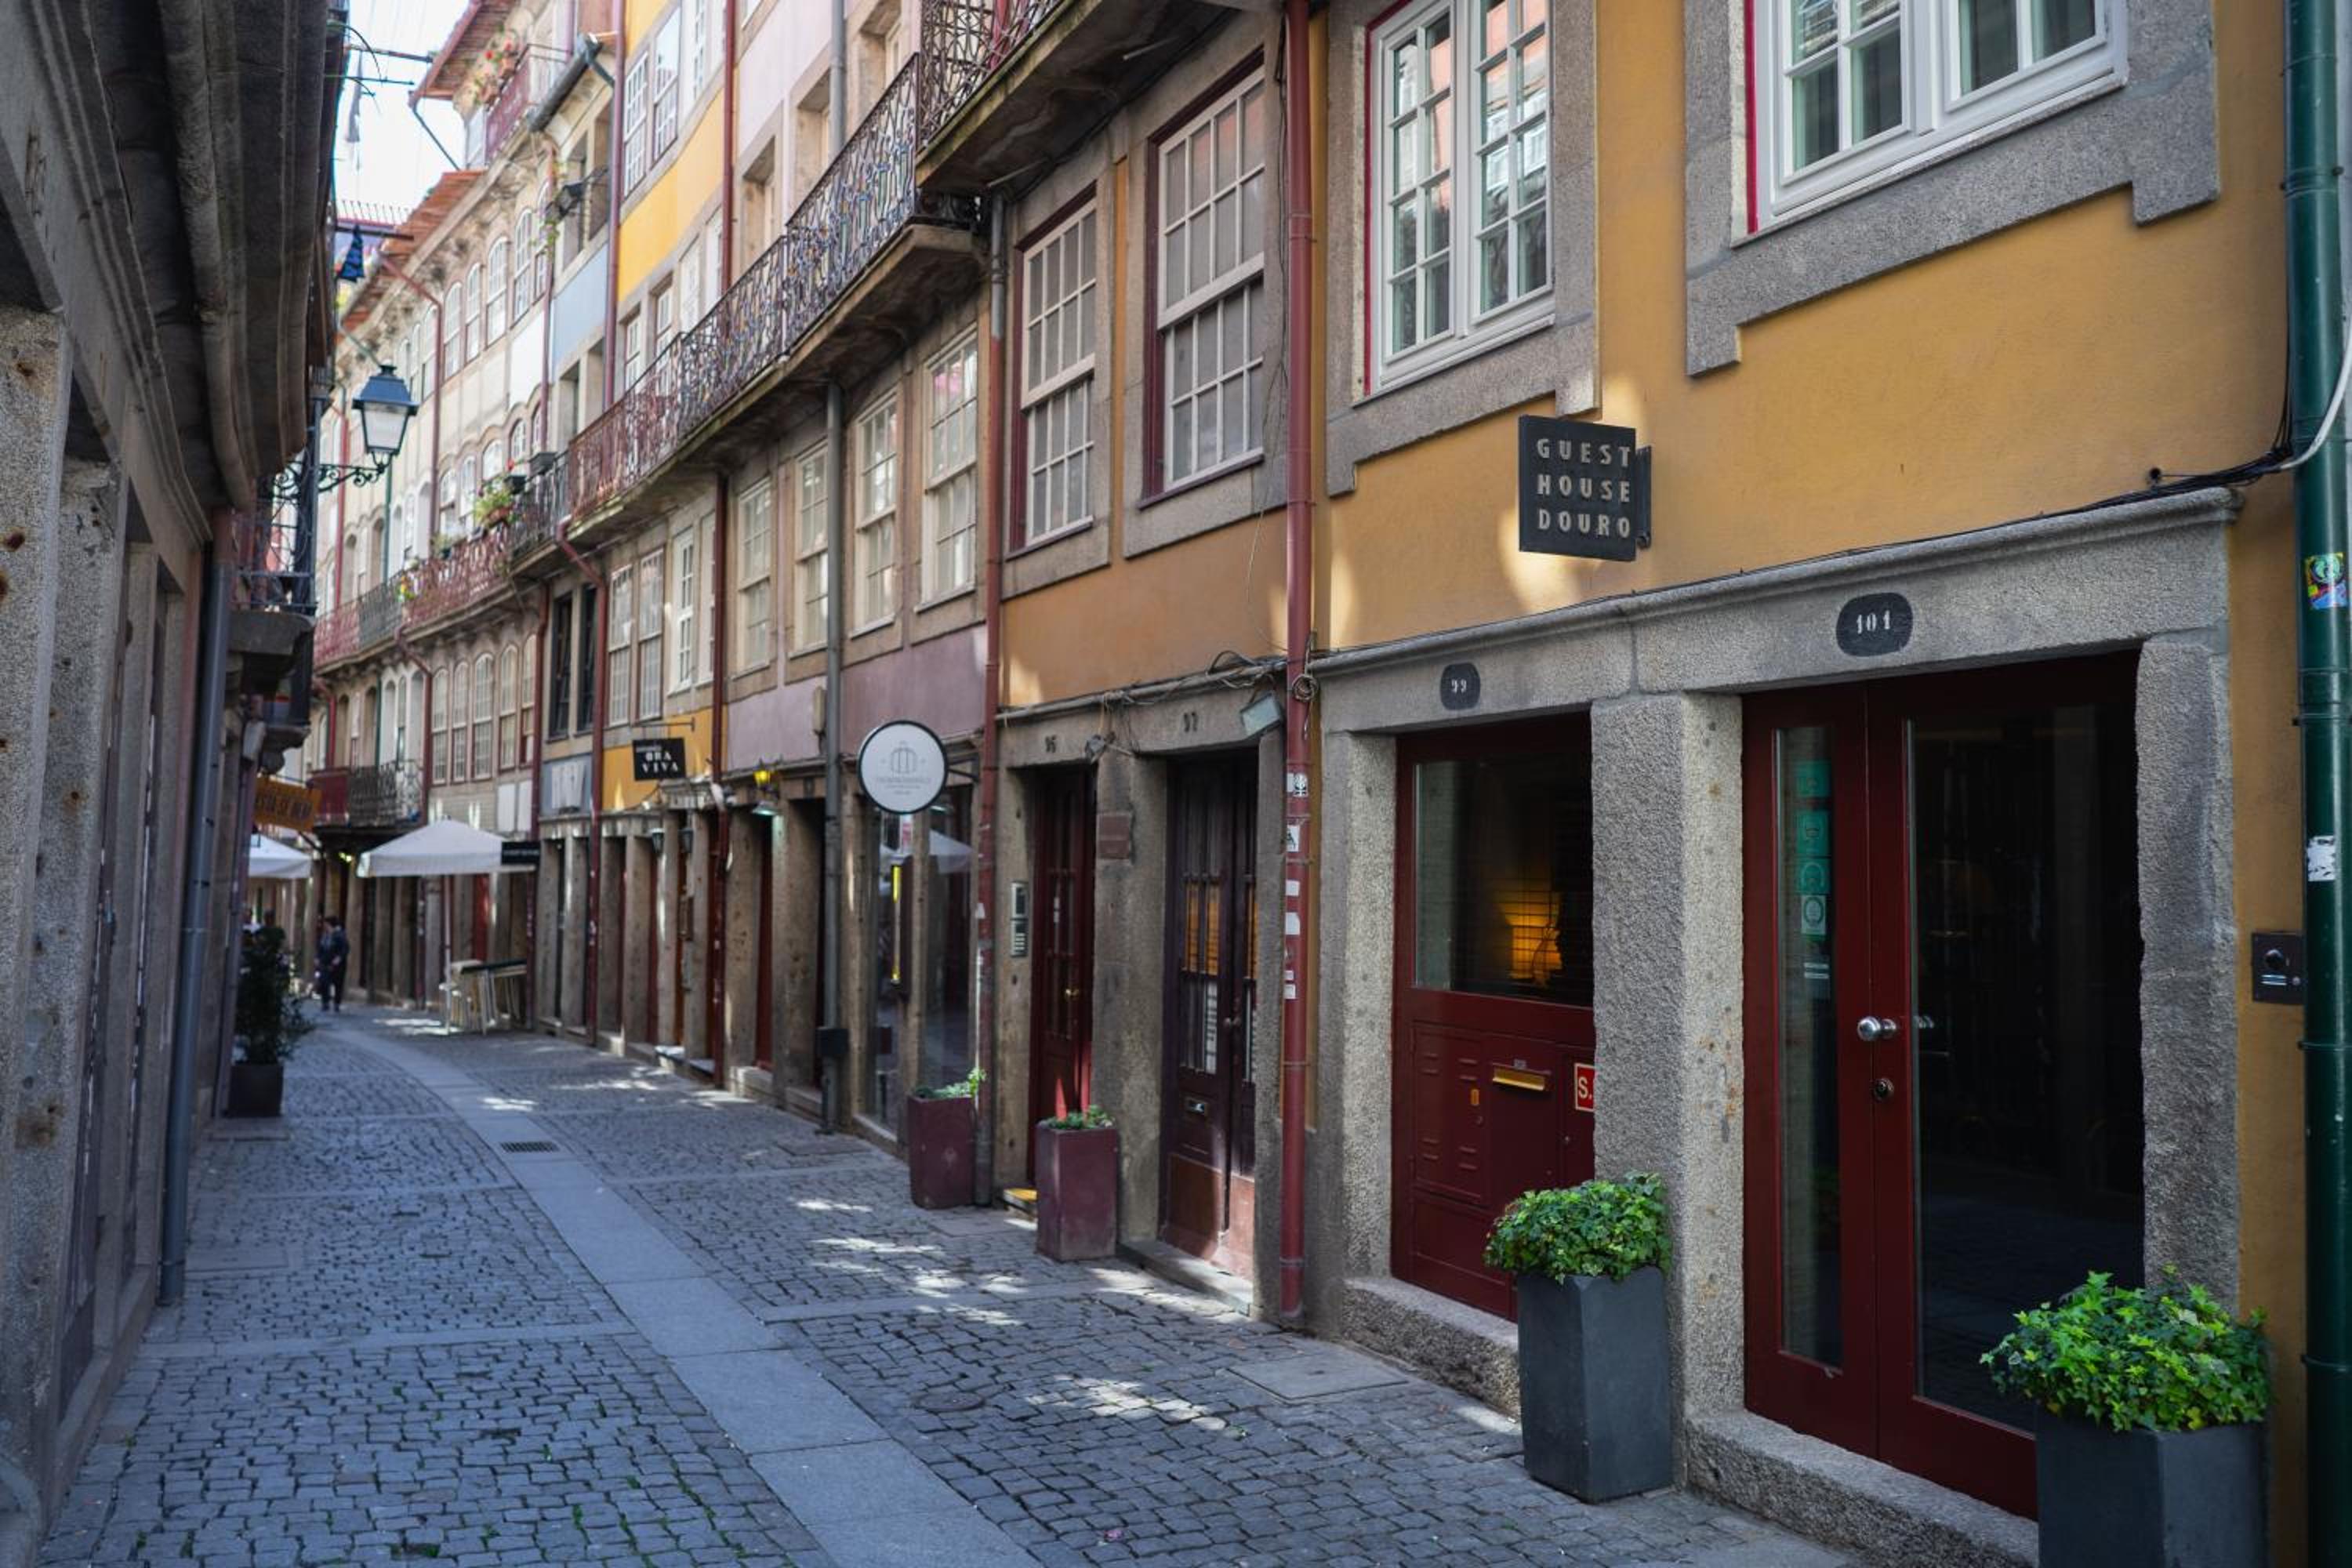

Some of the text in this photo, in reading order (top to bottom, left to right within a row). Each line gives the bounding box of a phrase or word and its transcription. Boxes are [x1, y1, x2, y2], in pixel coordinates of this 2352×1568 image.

[1537, 438, 1631, 467] GUEST
[1537, 474, 1631, 503] HOUSE
[1538, 509, 1631, 539] DOURO
[1857, 610, 1890, 634] 101
[642, 761, 679, 773] VIVA
